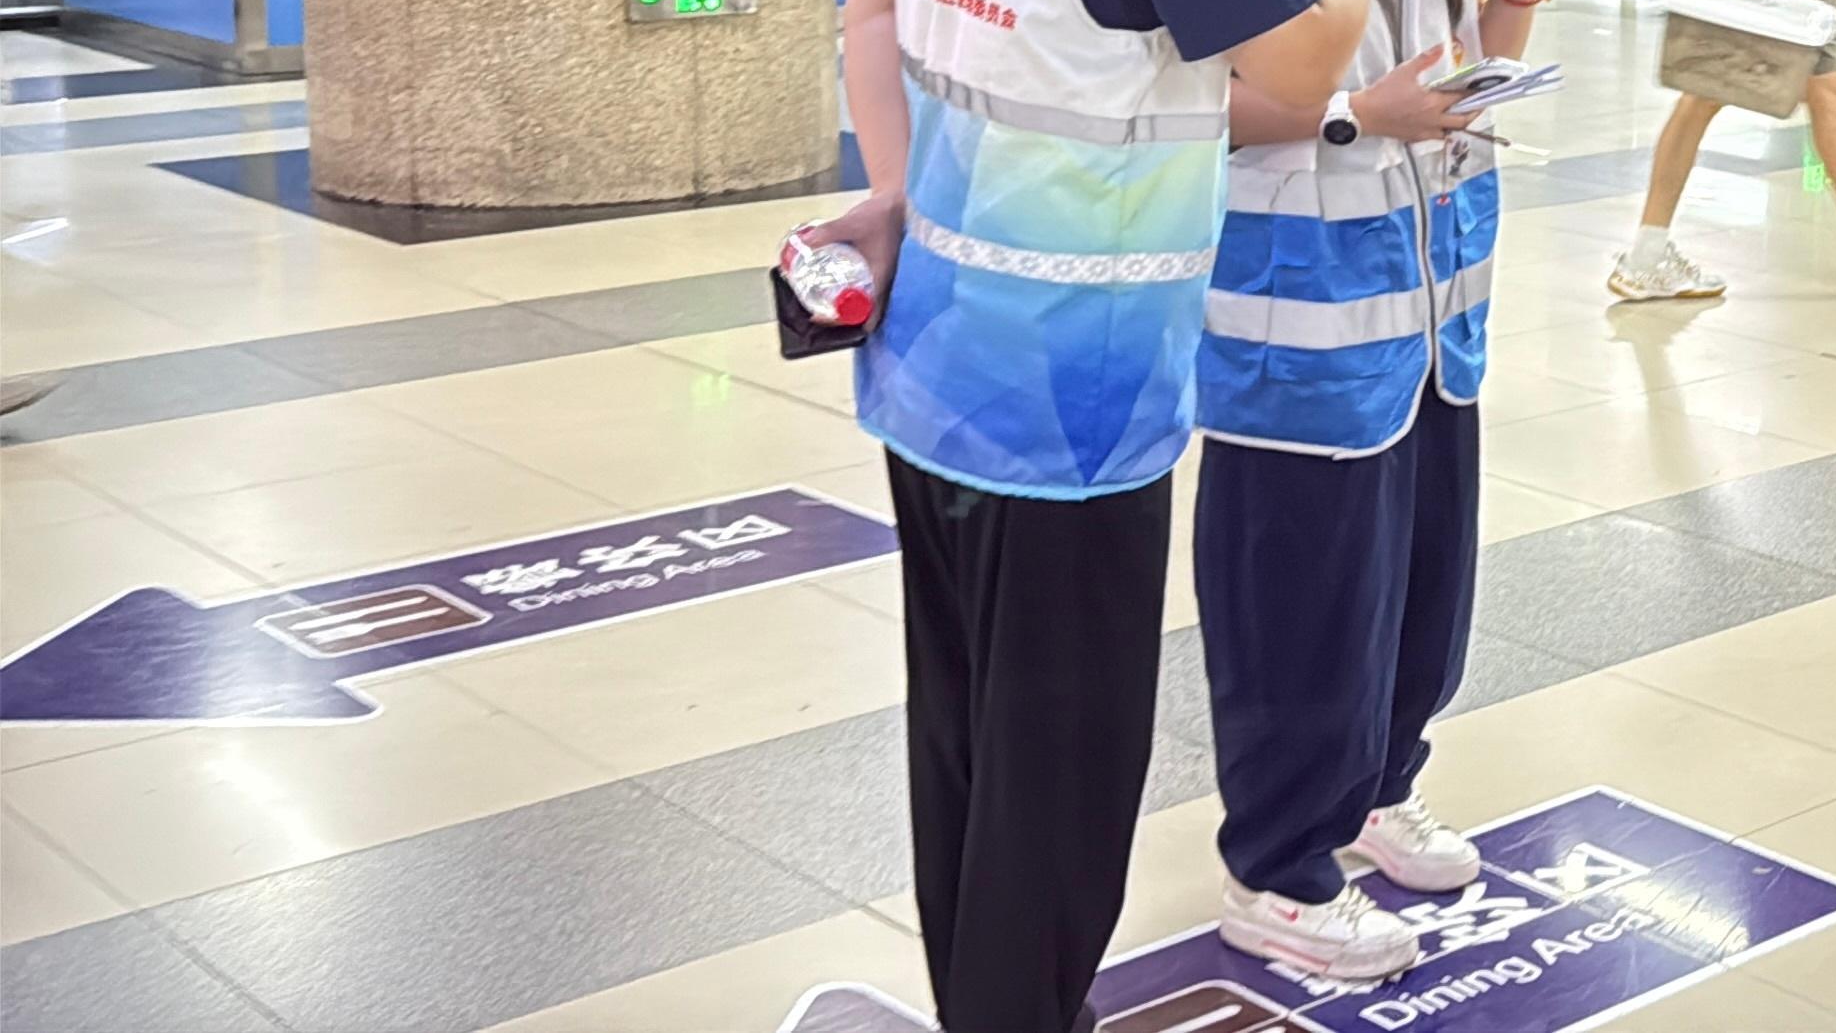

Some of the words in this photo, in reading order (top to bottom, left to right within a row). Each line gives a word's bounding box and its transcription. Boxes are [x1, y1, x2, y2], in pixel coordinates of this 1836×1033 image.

[507, 572, 661, 612] Dining
[663, 548, 768, 580] Area
[1264, 841, 1650, 998] 饮区
[1358, 954, 1544, 1031] Dining
[1531, 905, 1656, 966] Area
